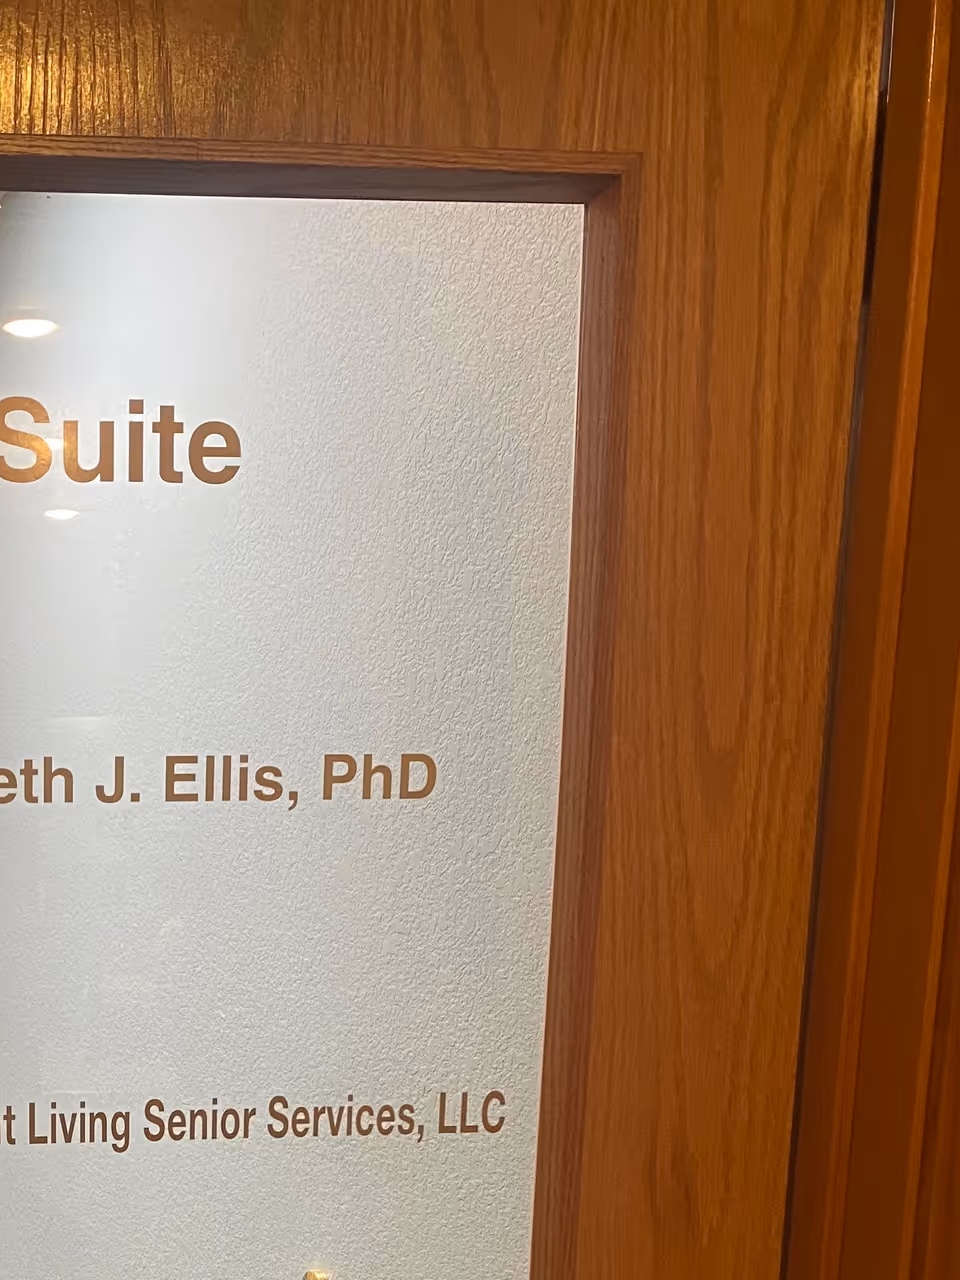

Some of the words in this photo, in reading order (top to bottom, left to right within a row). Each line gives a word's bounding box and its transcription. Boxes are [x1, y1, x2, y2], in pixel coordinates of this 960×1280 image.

[95, 755, 140, 803] J.
[164, 754, 298, 811] Ellis,
[322, 753, 437, 800] PhD
[28, 1100, 130, 1153] Living
[143, 1098, 256, 1142] Senior
[267, 1094, 424, 1143] Services,
[438, 1090, 506, 1134] LLC
